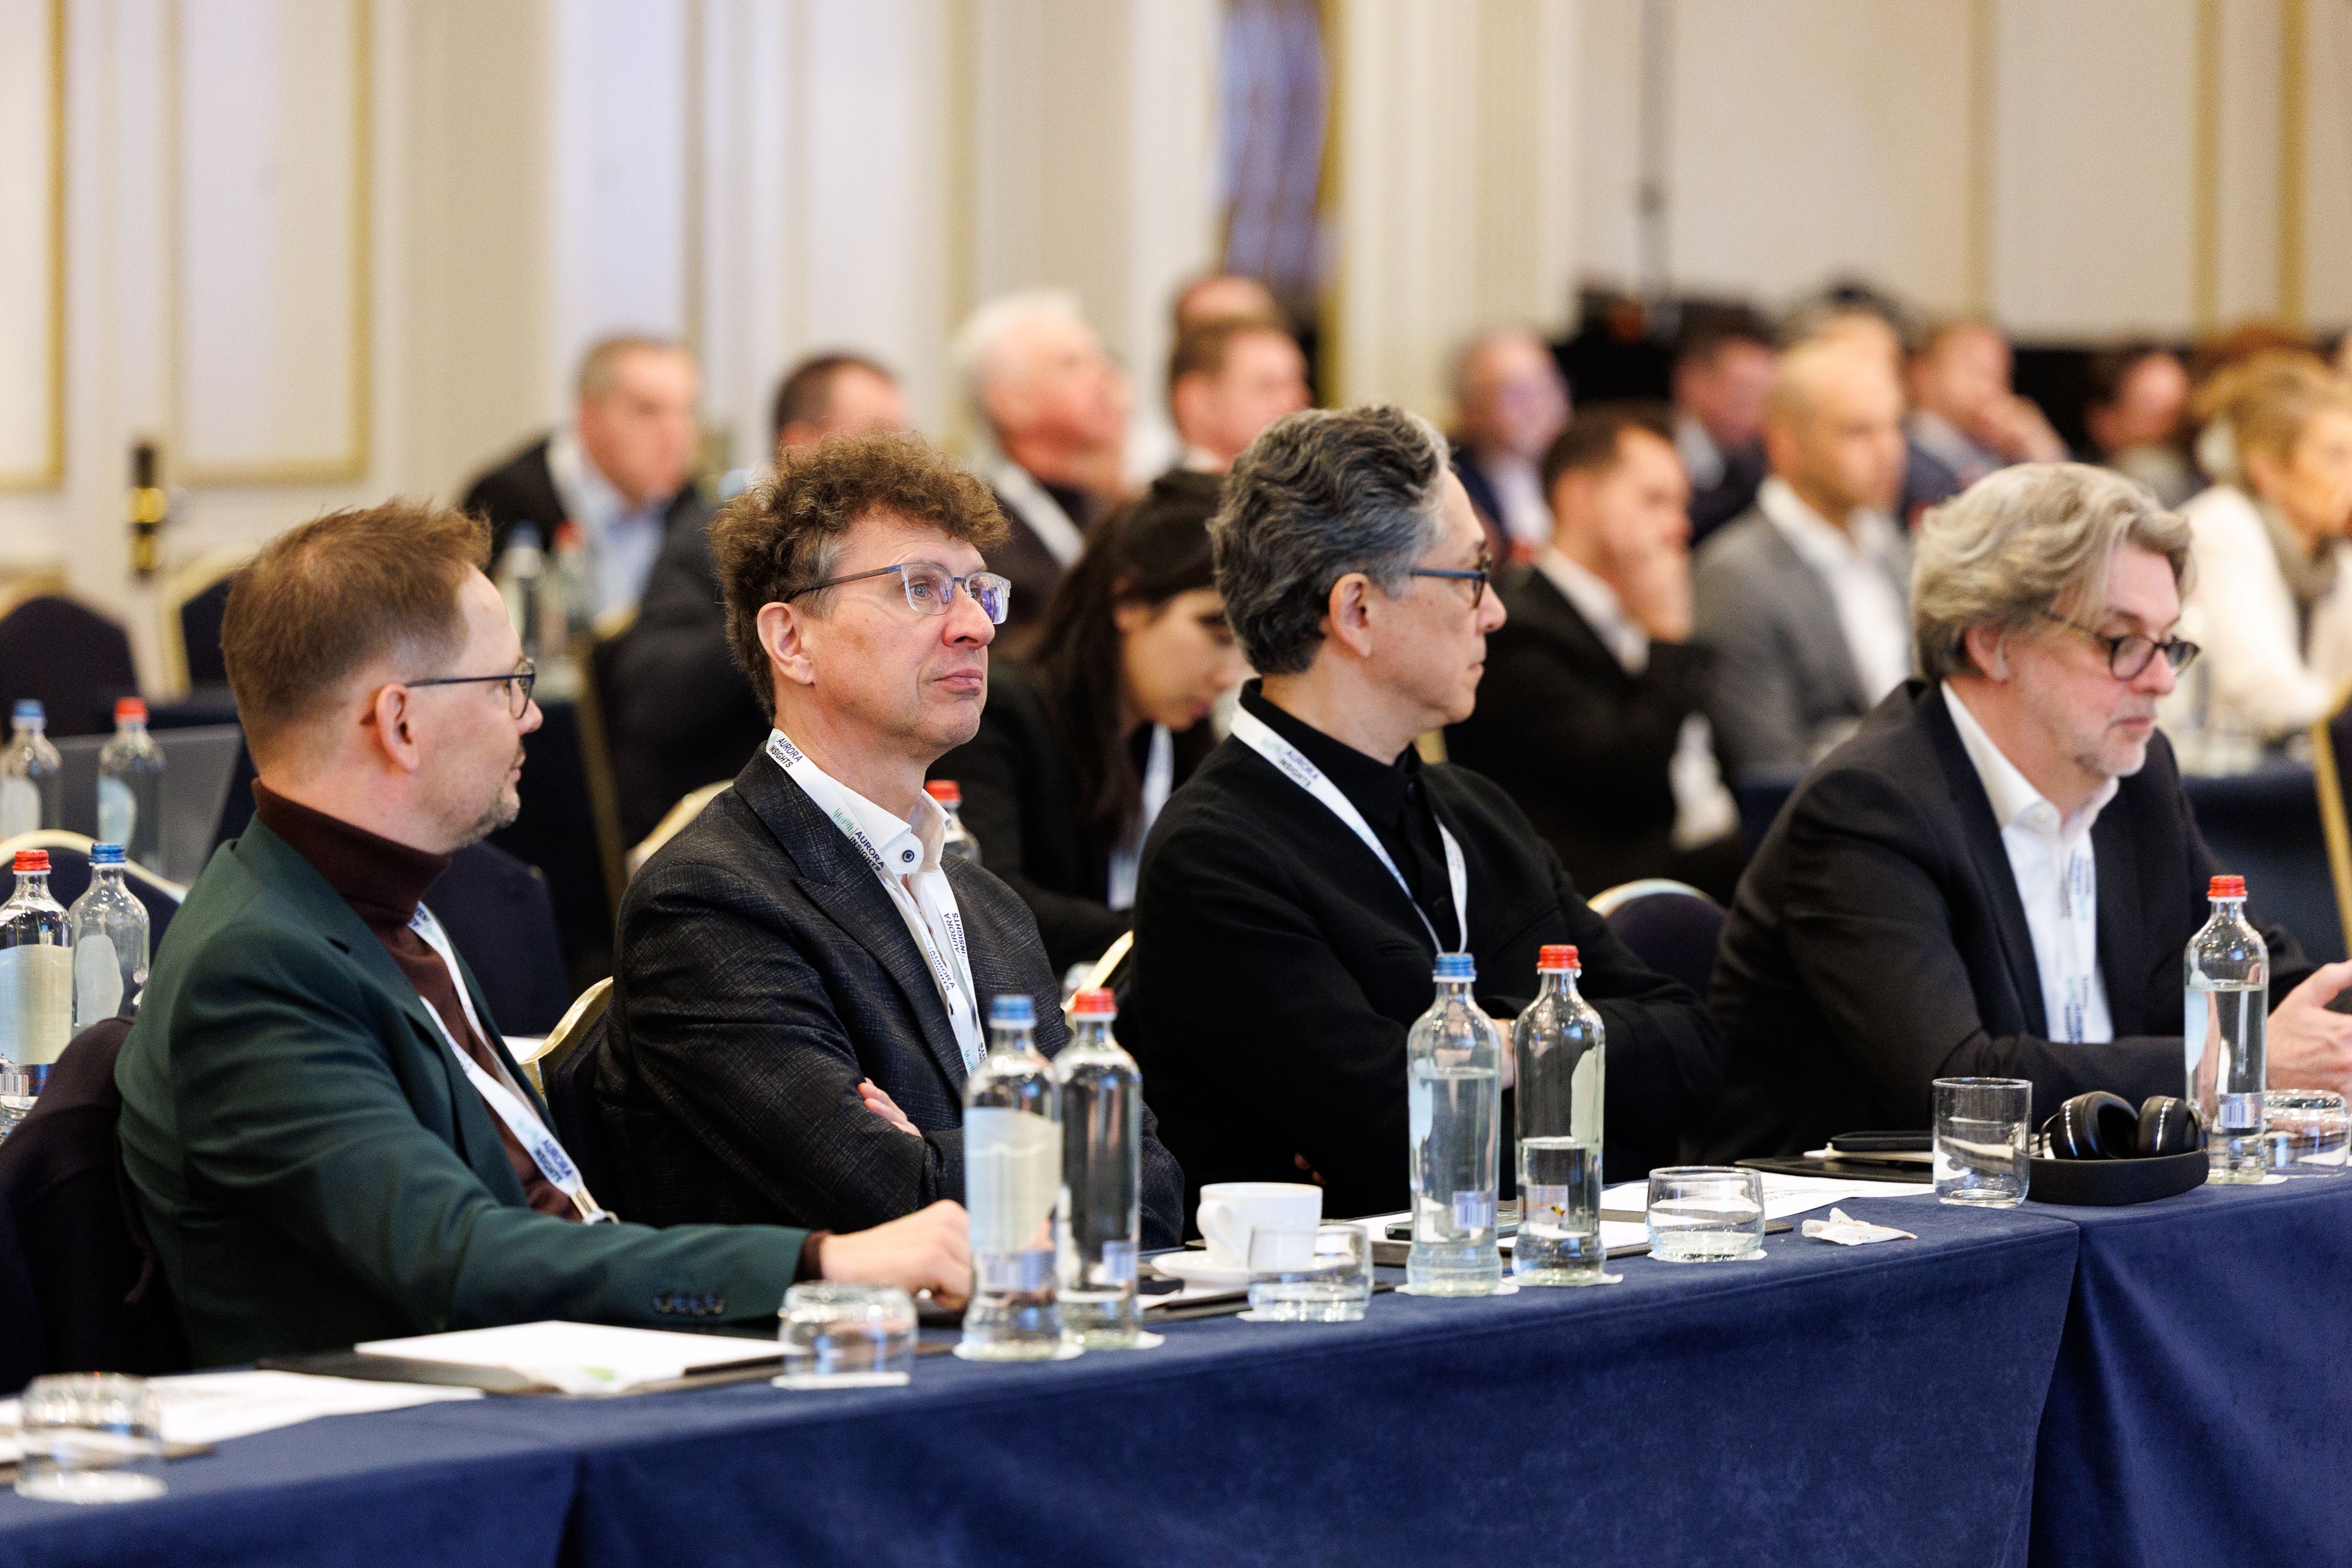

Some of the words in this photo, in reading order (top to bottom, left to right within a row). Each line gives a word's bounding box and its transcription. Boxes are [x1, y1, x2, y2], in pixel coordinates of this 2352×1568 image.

[769, 744, 793, 767] INSIGHTS
[777, 737, 803, 762] AURORA
[850, 837, 881, 871] INSIGHTS
[854, 831, 884, 868] AURORA
[944, 913, 960, 953] AURORA
[952, 913, 966, 954] INSIGHTS
[931, 950, 955, 988] AURORA
